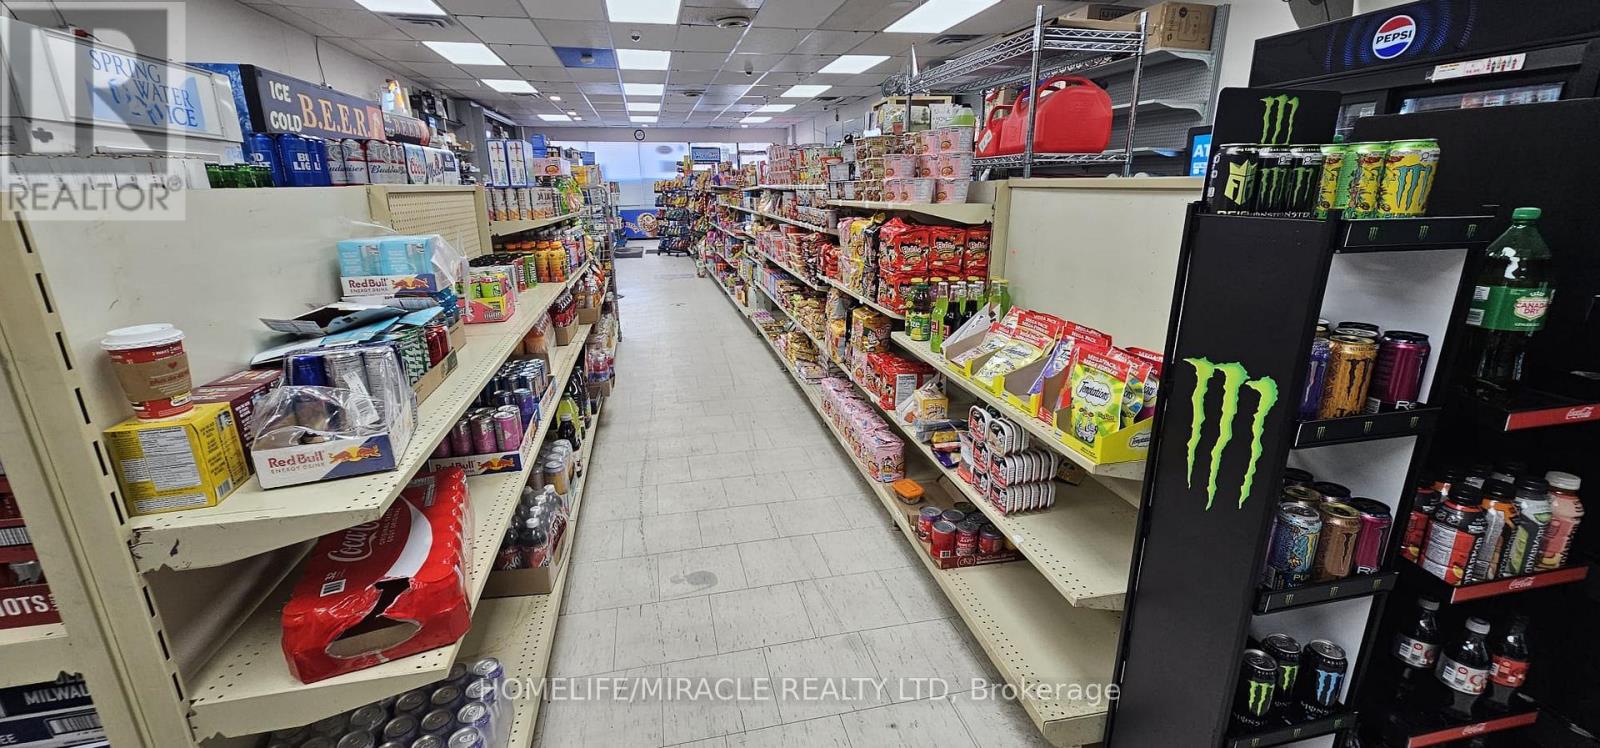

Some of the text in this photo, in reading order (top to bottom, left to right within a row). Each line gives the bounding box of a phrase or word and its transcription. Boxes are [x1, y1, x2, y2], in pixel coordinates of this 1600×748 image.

[1375, 29, 1413, 45] PEPSI
[89, 49, 162, 84] SPRING
[132, 78, 195, 110] WATER
[269, 81, 291, 102] ICE
[168, 106, 199, 128] ICE
[270, 111, 302, 132] COLD
[1193, 144, 1211, 157] AT
[348, 277, 389, 288] Red Bull
[1079, 380, 1110, 401] Temptations
[268, 450, 325, 469] Red Bull
